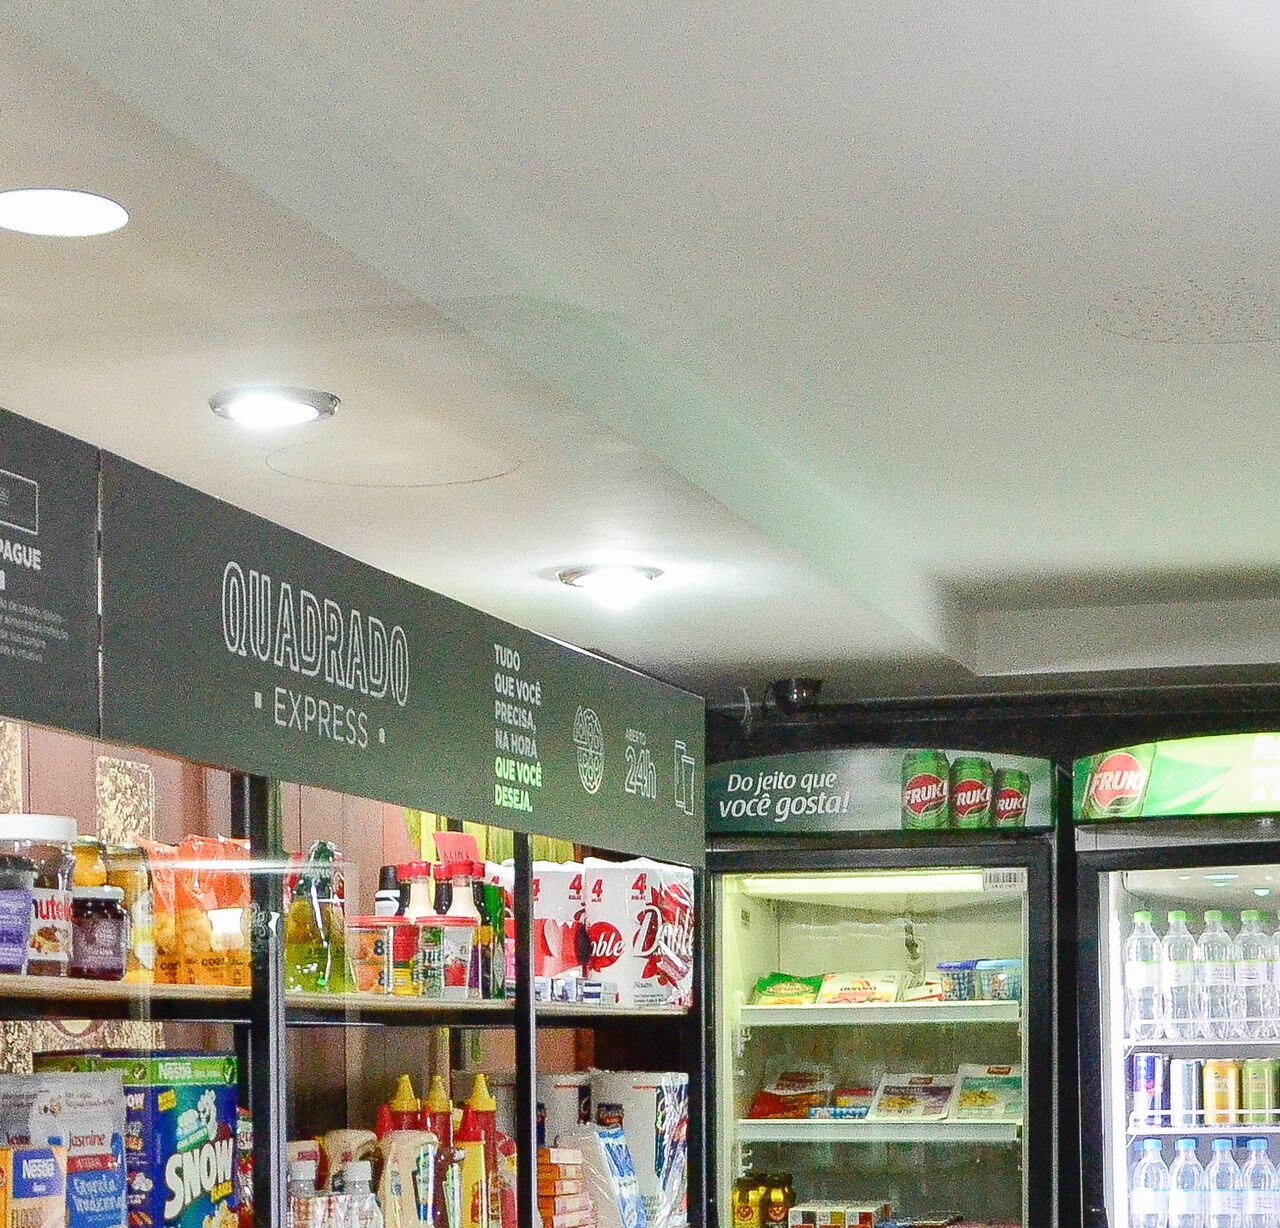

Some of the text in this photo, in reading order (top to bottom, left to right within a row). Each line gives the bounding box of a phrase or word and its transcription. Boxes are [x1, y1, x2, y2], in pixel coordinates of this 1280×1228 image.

[222, 561, 409, 706] QUADRADO
[494, 644, 521, 671] TUDO
[494, 673, 542, 705] QUE VOCÊ
[274, 686, 368, 748] EXPRESS
[494, 700, 536, 734] PRECISA,
[495, 729, 538, 758] NA HORA
[494, 756, 542, 788] QUE VOCÊ
[625, 746, 657, 799] 24h
[727, 771, 838, 796] Do jeito que
[494, 784, 533, 812] DESEJA.
[719, 791, 849, 823] você gosta!
[570, 873, 582, 896] 4
[592, 879, 603, 899] 4
[632, 873, 648, 895] 4
[165, 1138, 235, 1222] SNOW
